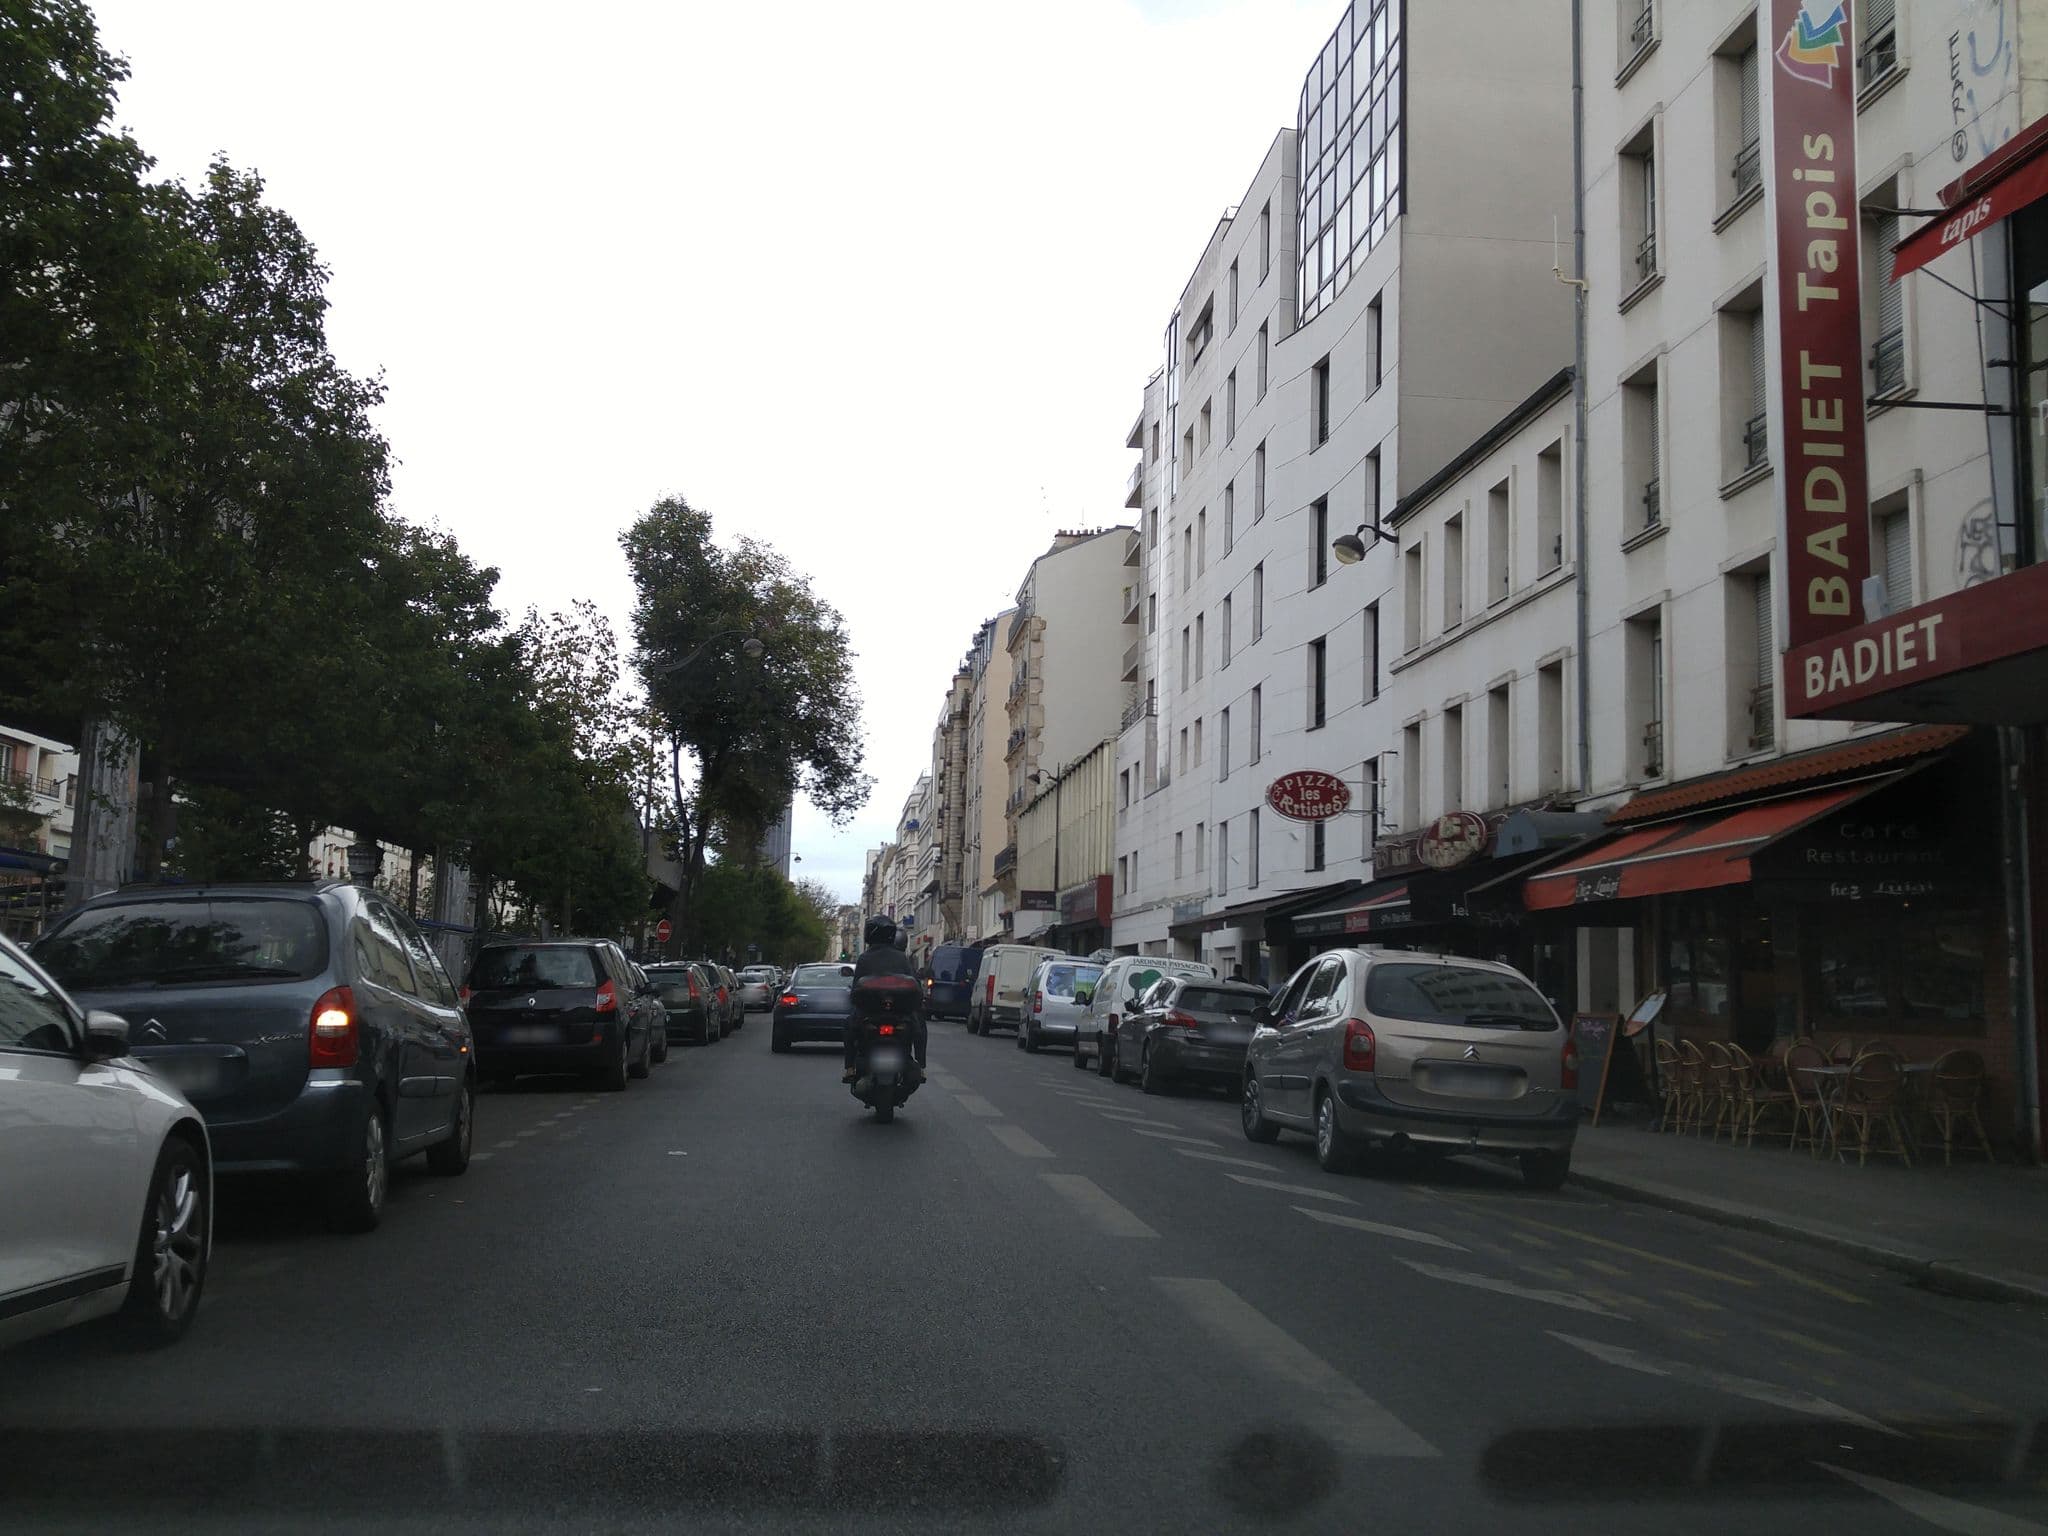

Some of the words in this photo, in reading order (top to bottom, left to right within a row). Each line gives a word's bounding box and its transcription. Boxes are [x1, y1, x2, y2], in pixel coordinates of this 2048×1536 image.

[1792, 133, 1849, 312] Tapis
[1941, 197, 1992, 245] tapis
[1800, 350, 1851, 616] BADIET
[1805, 613, 1944, 699] BADIET
[1283, 774, 1338, 791] PIZZA
[1300, 787, 1320, 801] les
